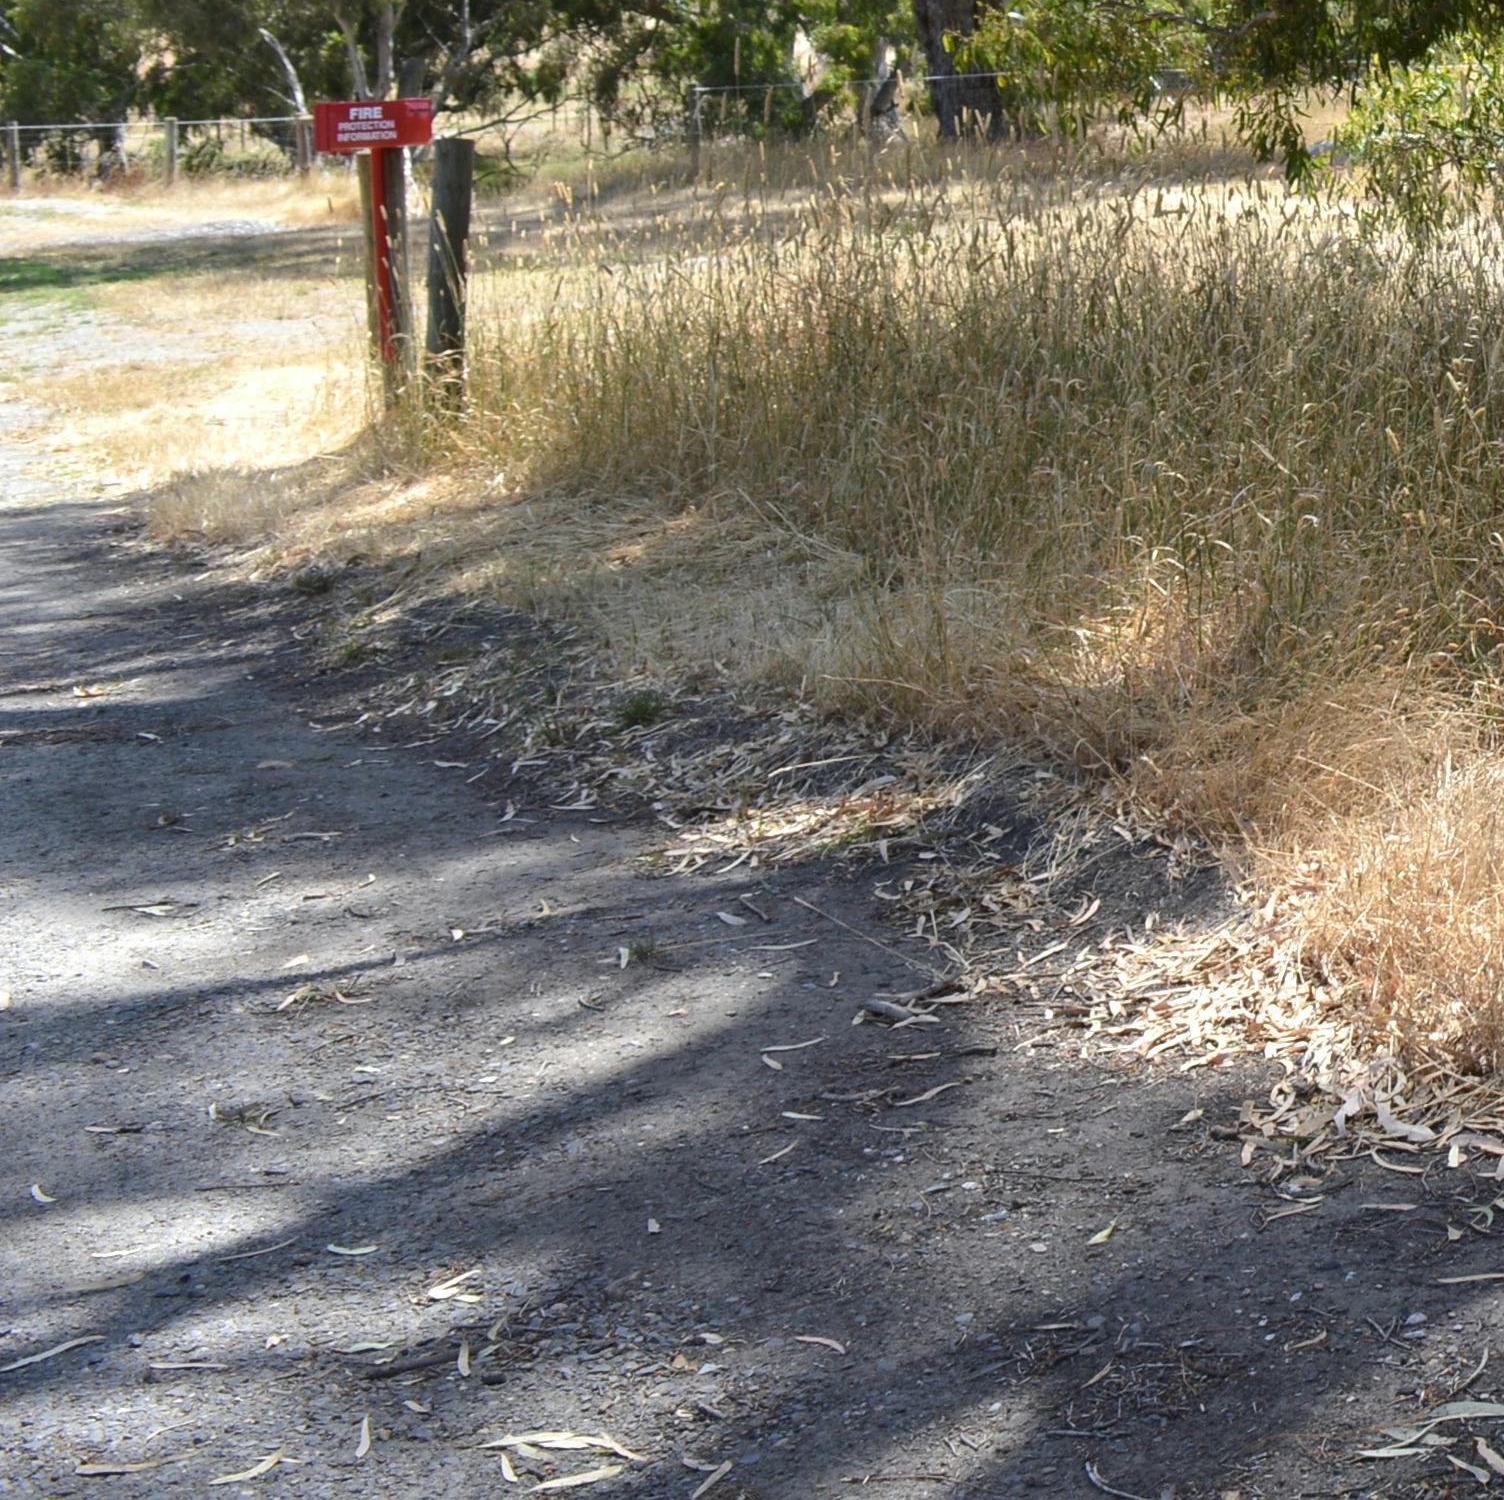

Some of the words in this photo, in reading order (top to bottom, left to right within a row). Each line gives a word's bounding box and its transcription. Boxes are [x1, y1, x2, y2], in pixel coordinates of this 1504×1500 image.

[349, 107, 382, 120] FIRE
[338, 120, 395, 131] PROTECTION
[337, 131, 397, 141] INFORMATION
